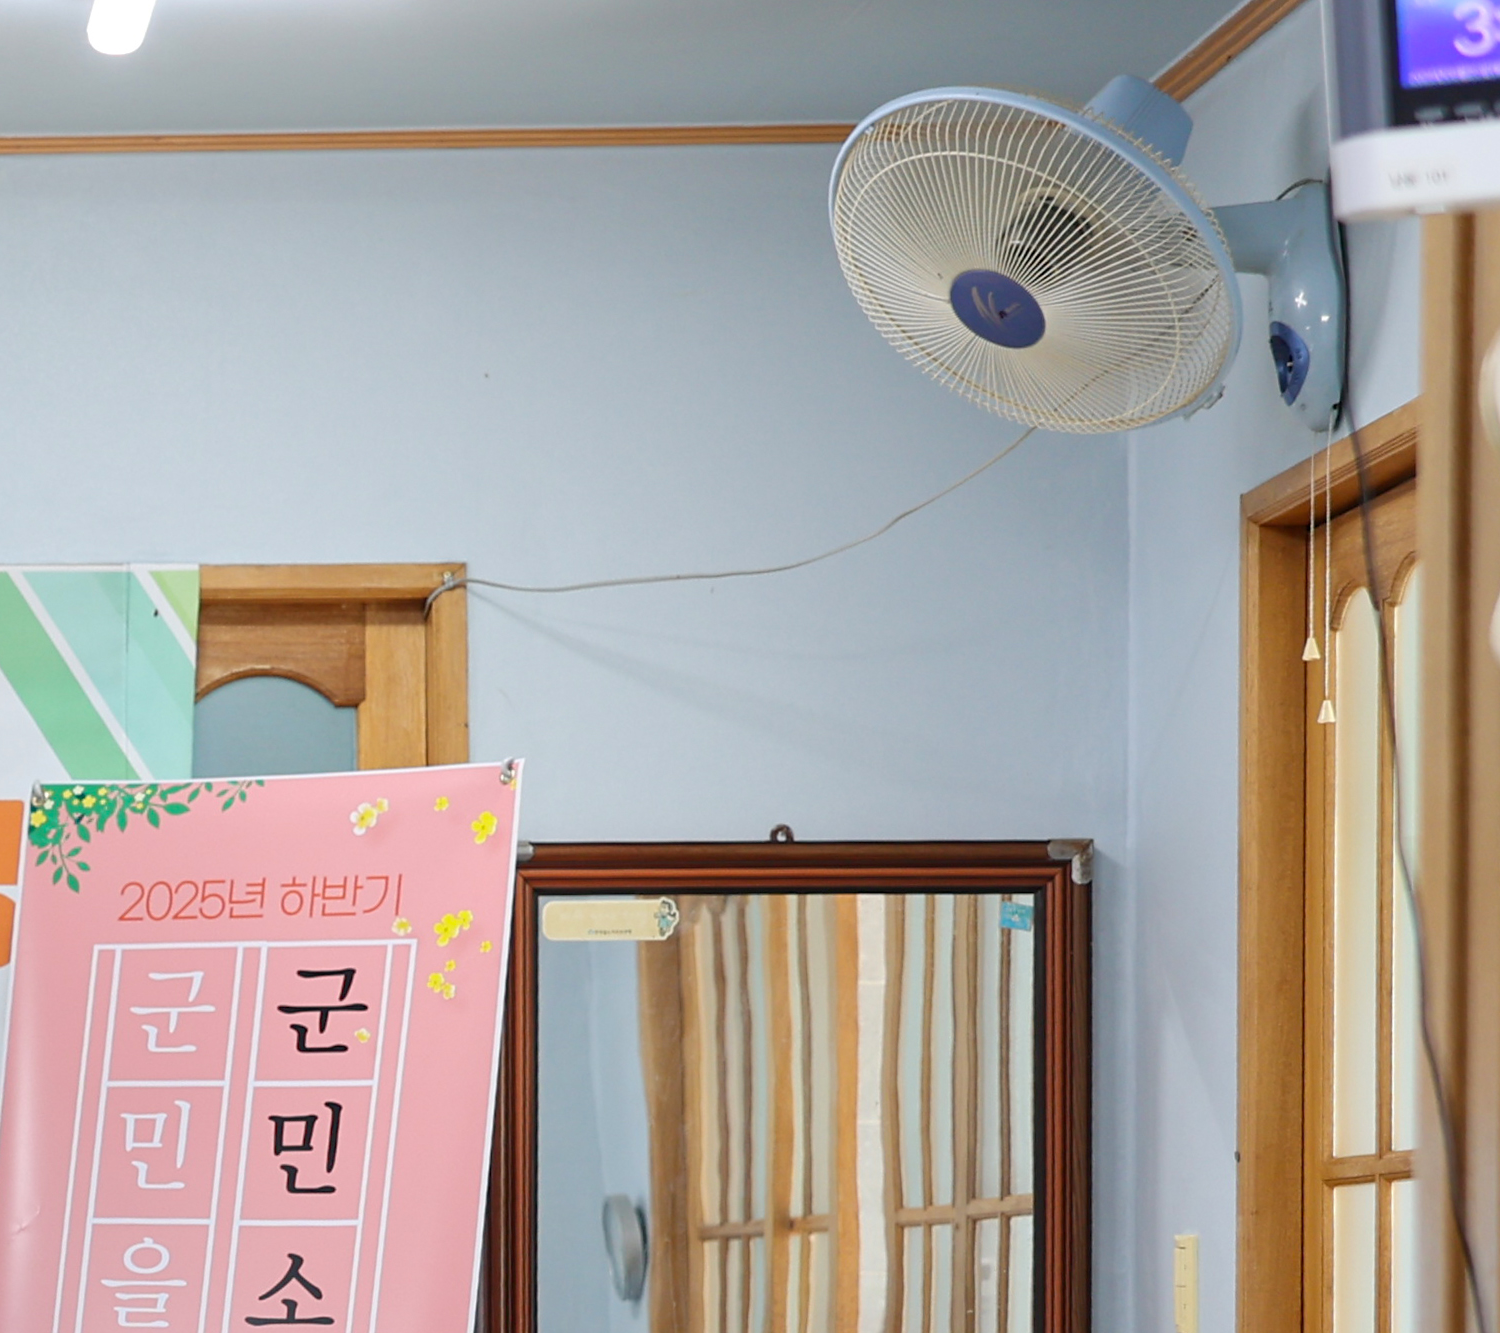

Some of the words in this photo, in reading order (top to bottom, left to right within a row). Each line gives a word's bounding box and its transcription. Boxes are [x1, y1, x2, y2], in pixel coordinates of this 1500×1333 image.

[118, 877, 266, 922] 2025년
[280, 874, 402, 918] 하반기
[101, 969, 215, 1328] 군민을
